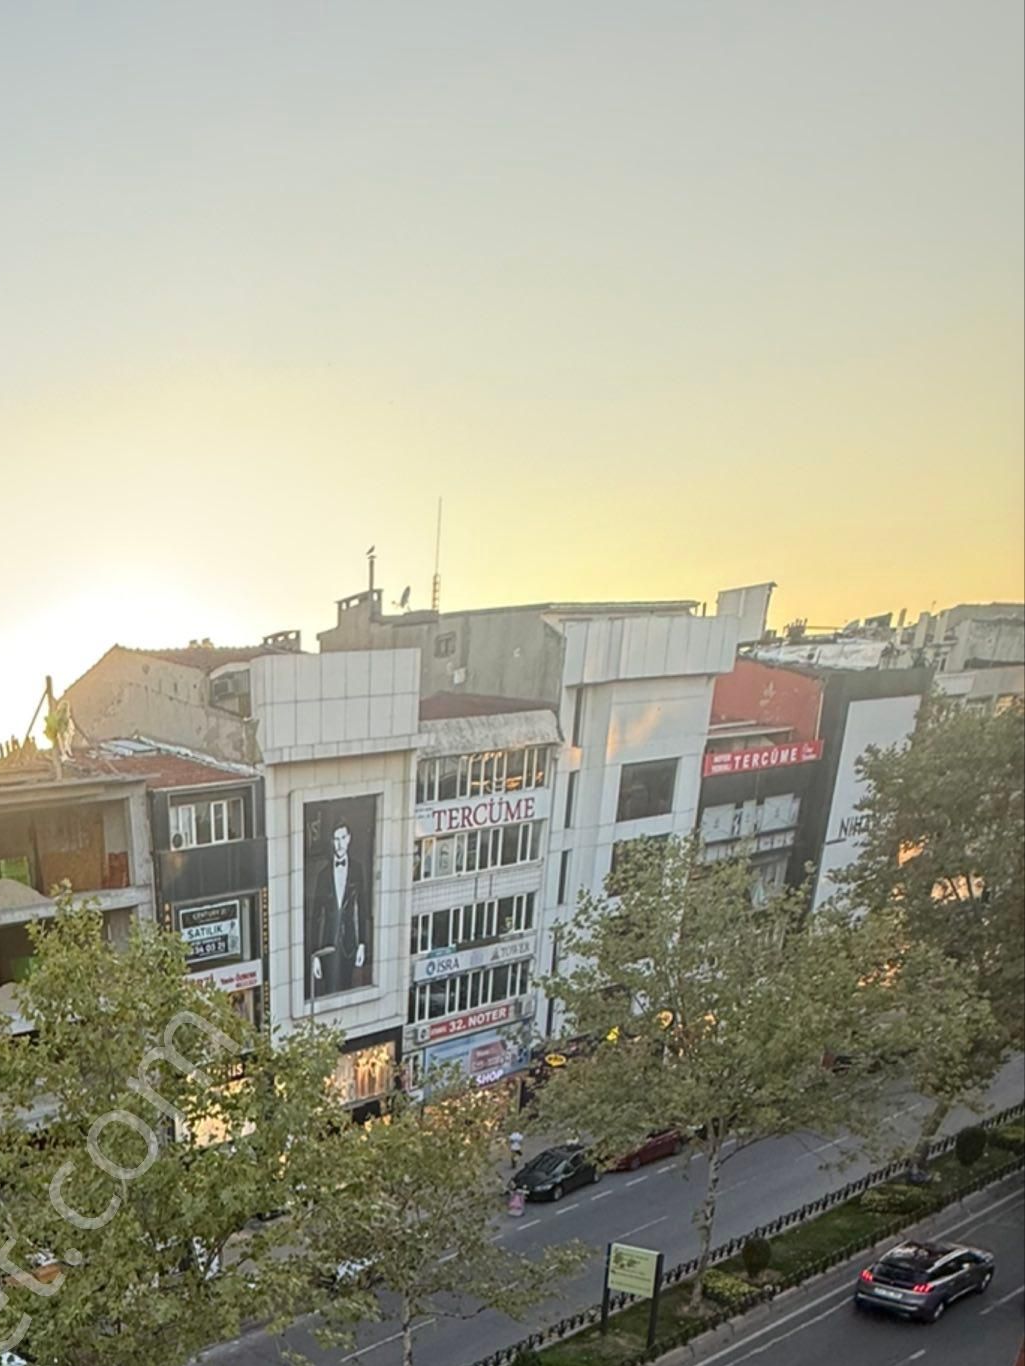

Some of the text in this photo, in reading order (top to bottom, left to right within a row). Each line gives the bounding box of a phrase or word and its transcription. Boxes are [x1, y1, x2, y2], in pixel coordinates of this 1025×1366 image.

[733, 747, 798, 769] TERCÜME
[432, 796, 536, 832] TERCÜME
[187, 924, 224, 939] SATILIK
[448, 1019, 467, 1033] 32.
[468, 1007, 508, 1027] NOTER
[476, 1069, 504, 1086] SHOP
